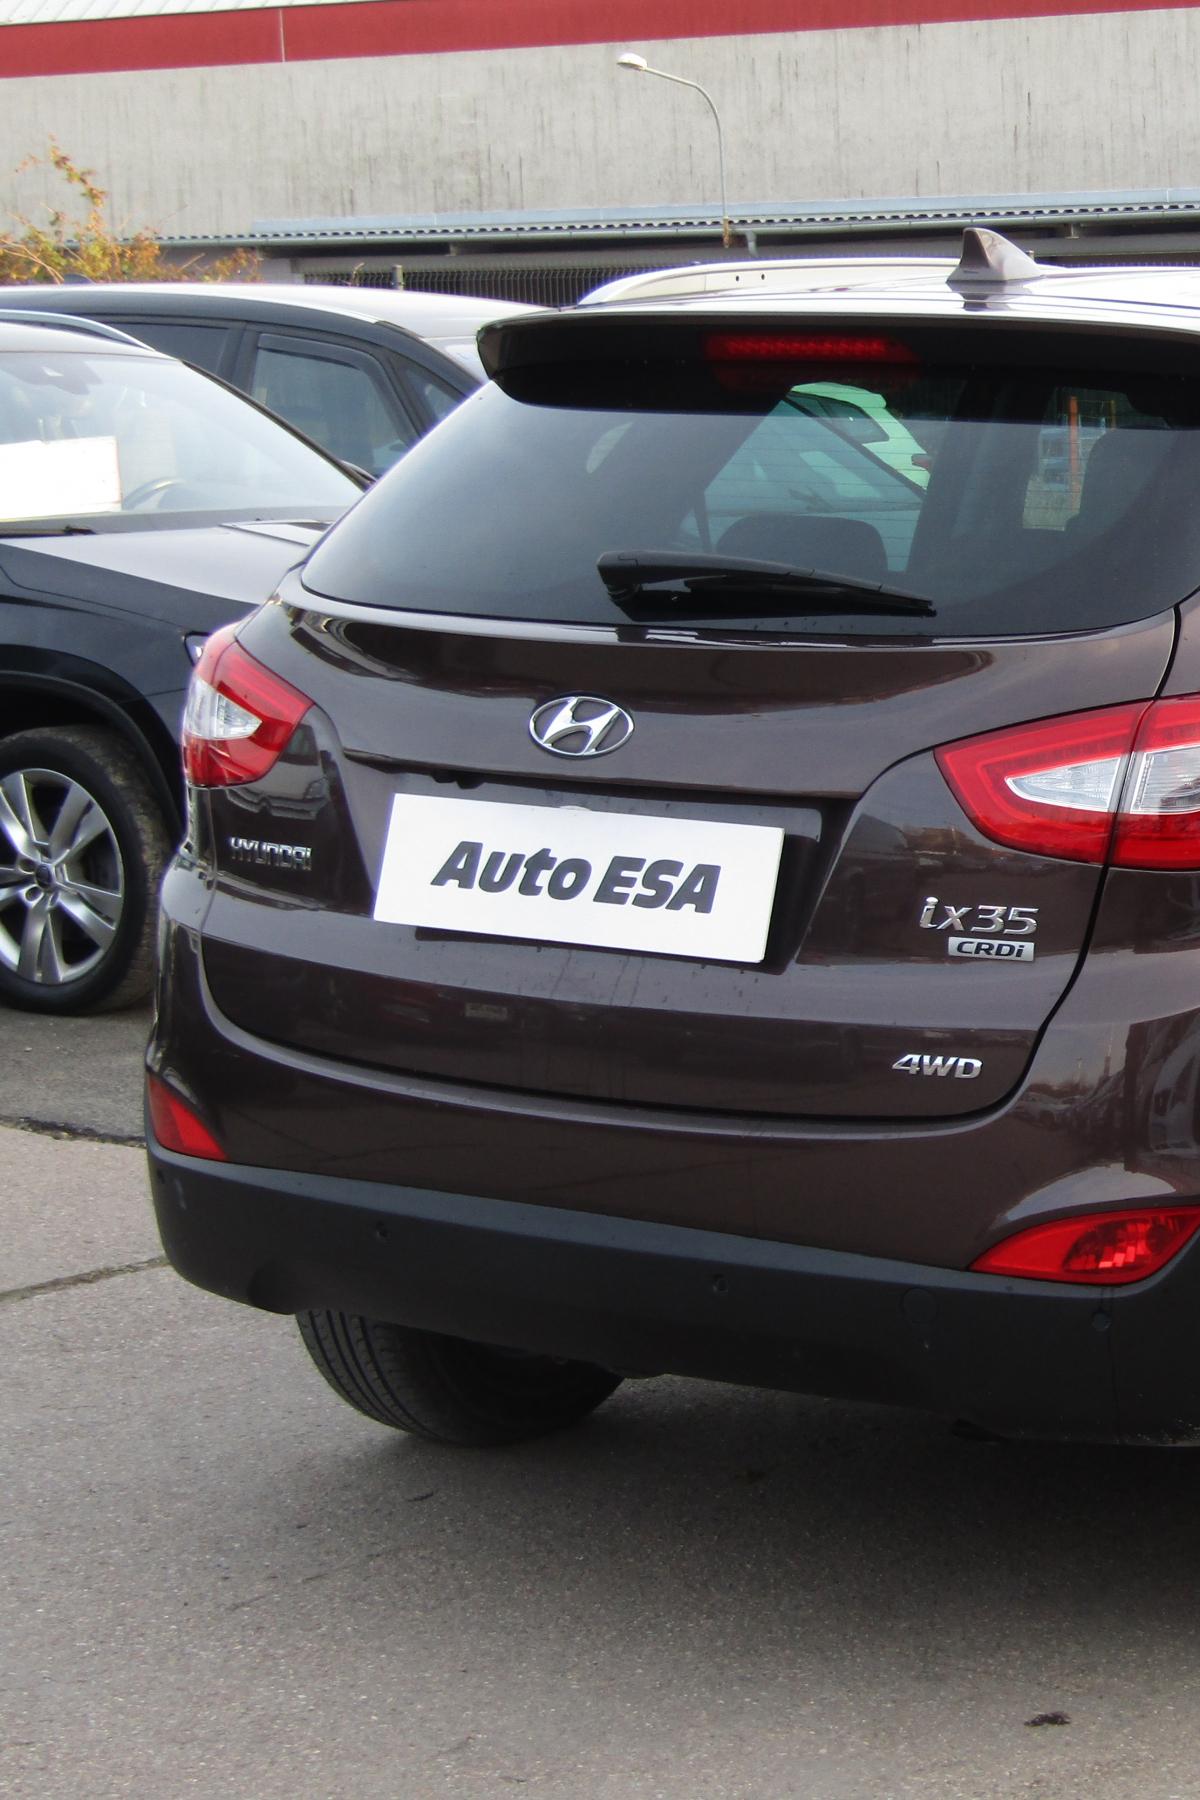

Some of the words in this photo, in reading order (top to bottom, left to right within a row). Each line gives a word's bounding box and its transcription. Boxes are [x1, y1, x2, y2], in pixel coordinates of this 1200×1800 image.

[430, 841, 593, 901] Auto
[593, 856, 722, 914] ESA
[919, 896, 1040, 935] ix35
[956, 941, 1025, 958] CRDi
[891, 1053, 983, 1079] 4WD
